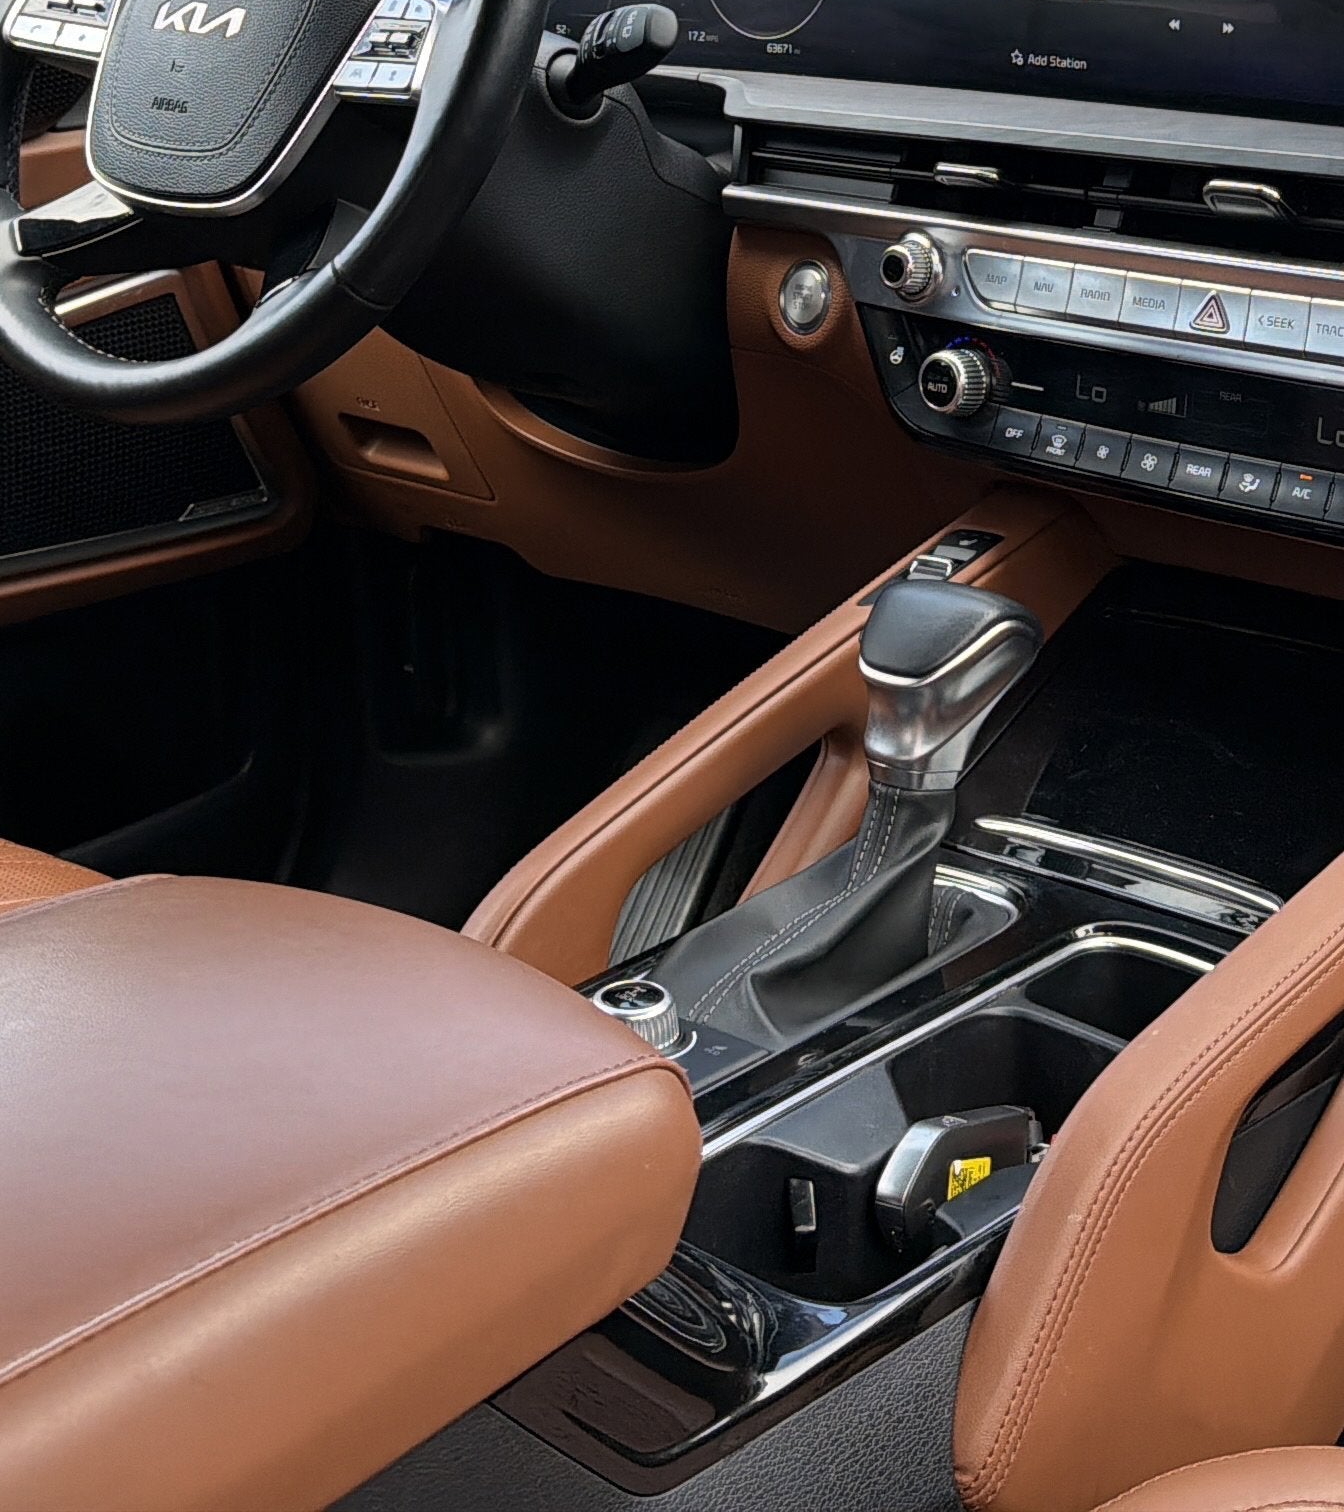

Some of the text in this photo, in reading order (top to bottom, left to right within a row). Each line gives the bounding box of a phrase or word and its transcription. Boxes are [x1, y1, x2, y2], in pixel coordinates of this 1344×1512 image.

[688, 31, 706, 42] 17.2
[766, 43, 792, 55] 63671
[1027, 53, 1087, 70] Add Station
[984, 273, 1007, 286] MAP
[1033, 281, 1054, 293] NAV
[1080, 288, 1111, 302] RADIO
[1132, 296, 1166, 311] MEDIA
[1267, 316, 1295, 330] SEEK
[927, 382, 948, 394] AUTO
[1075, 374, 1107, 403] Lo
[1219, 391, 1243, 403] REAR
[1005, 427, 1024, 439] OFF
[1186, 463, 1212, 478] REAR
[1292, 486, 1312, 500] A/C
